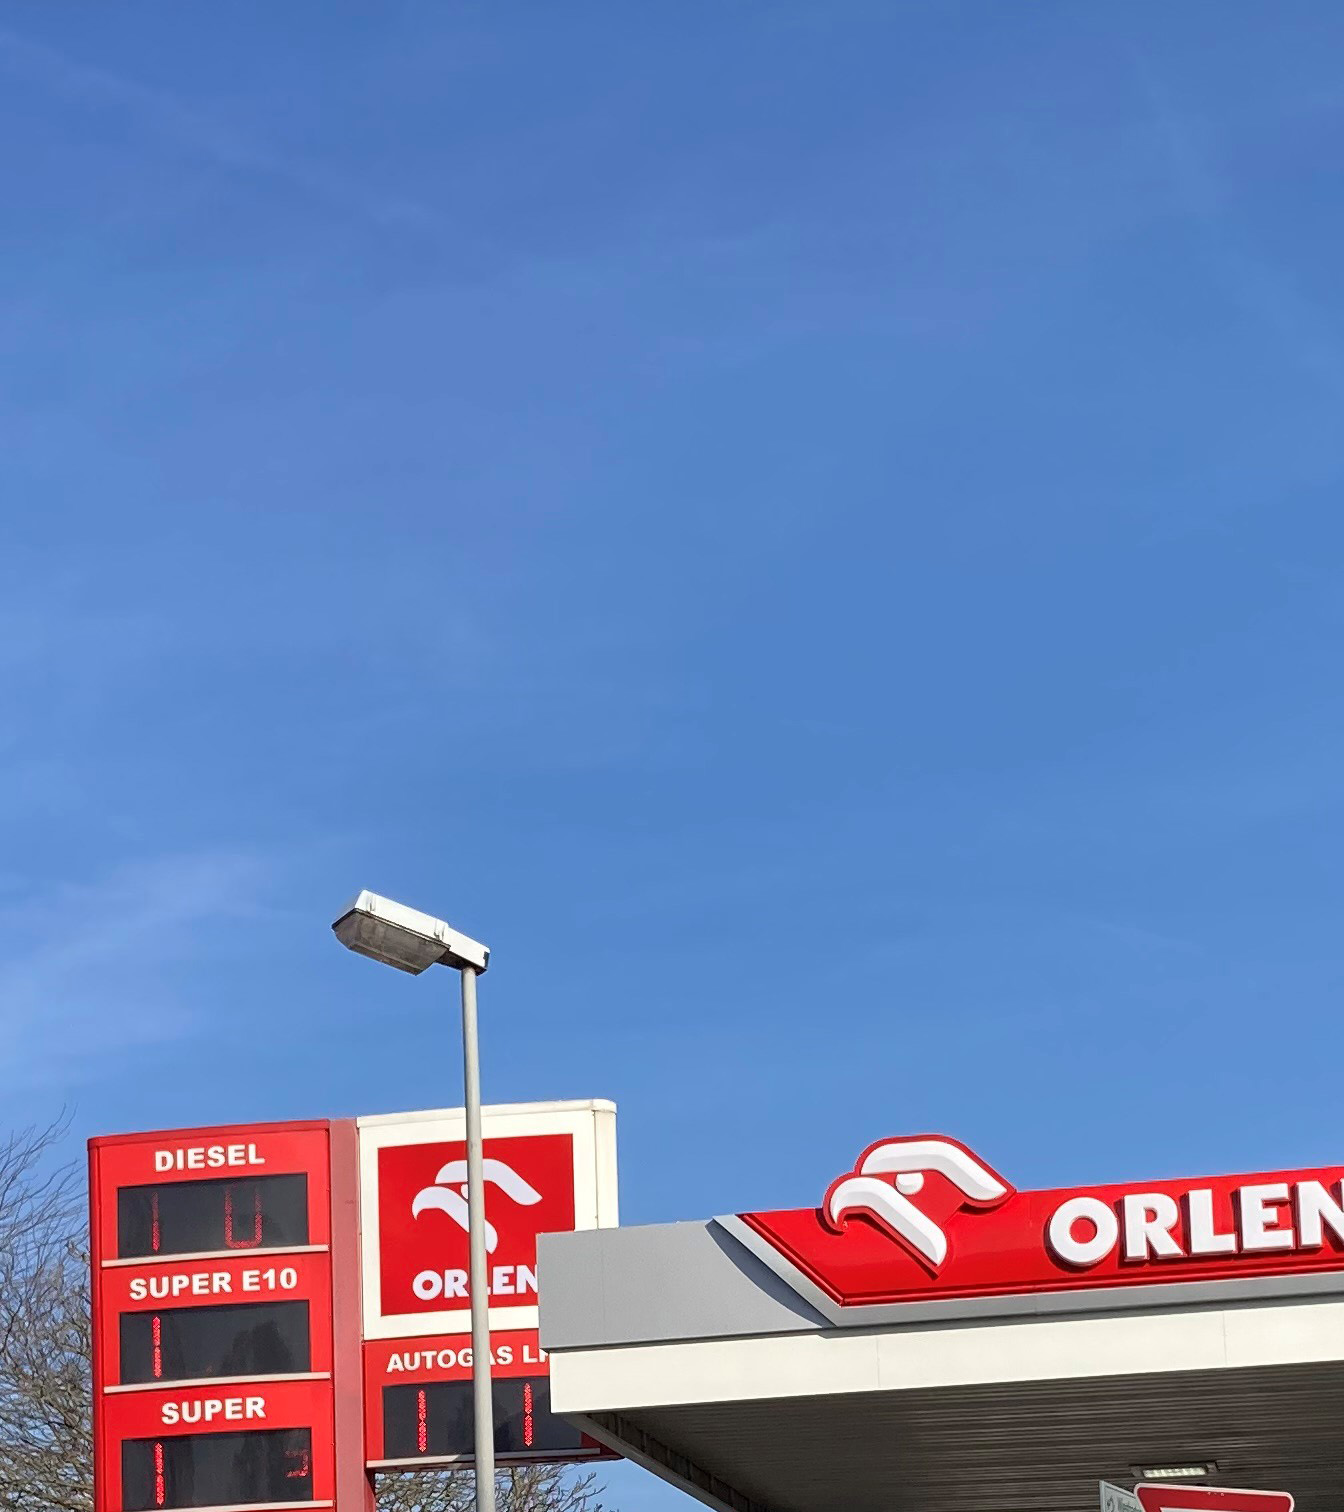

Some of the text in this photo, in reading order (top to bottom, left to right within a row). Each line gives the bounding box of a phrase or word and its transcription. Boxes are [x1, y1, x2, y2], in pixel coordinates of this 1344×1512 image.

[154, 1143, 266, 1173] DIESEL
[129, 1267, 299, 1301] SUPER E10
[412, 1264, 538, 1300] OREN
[386, 1345, 513, 1373] AUTOGS
[161, 1396, 267, 1425] SUPER
